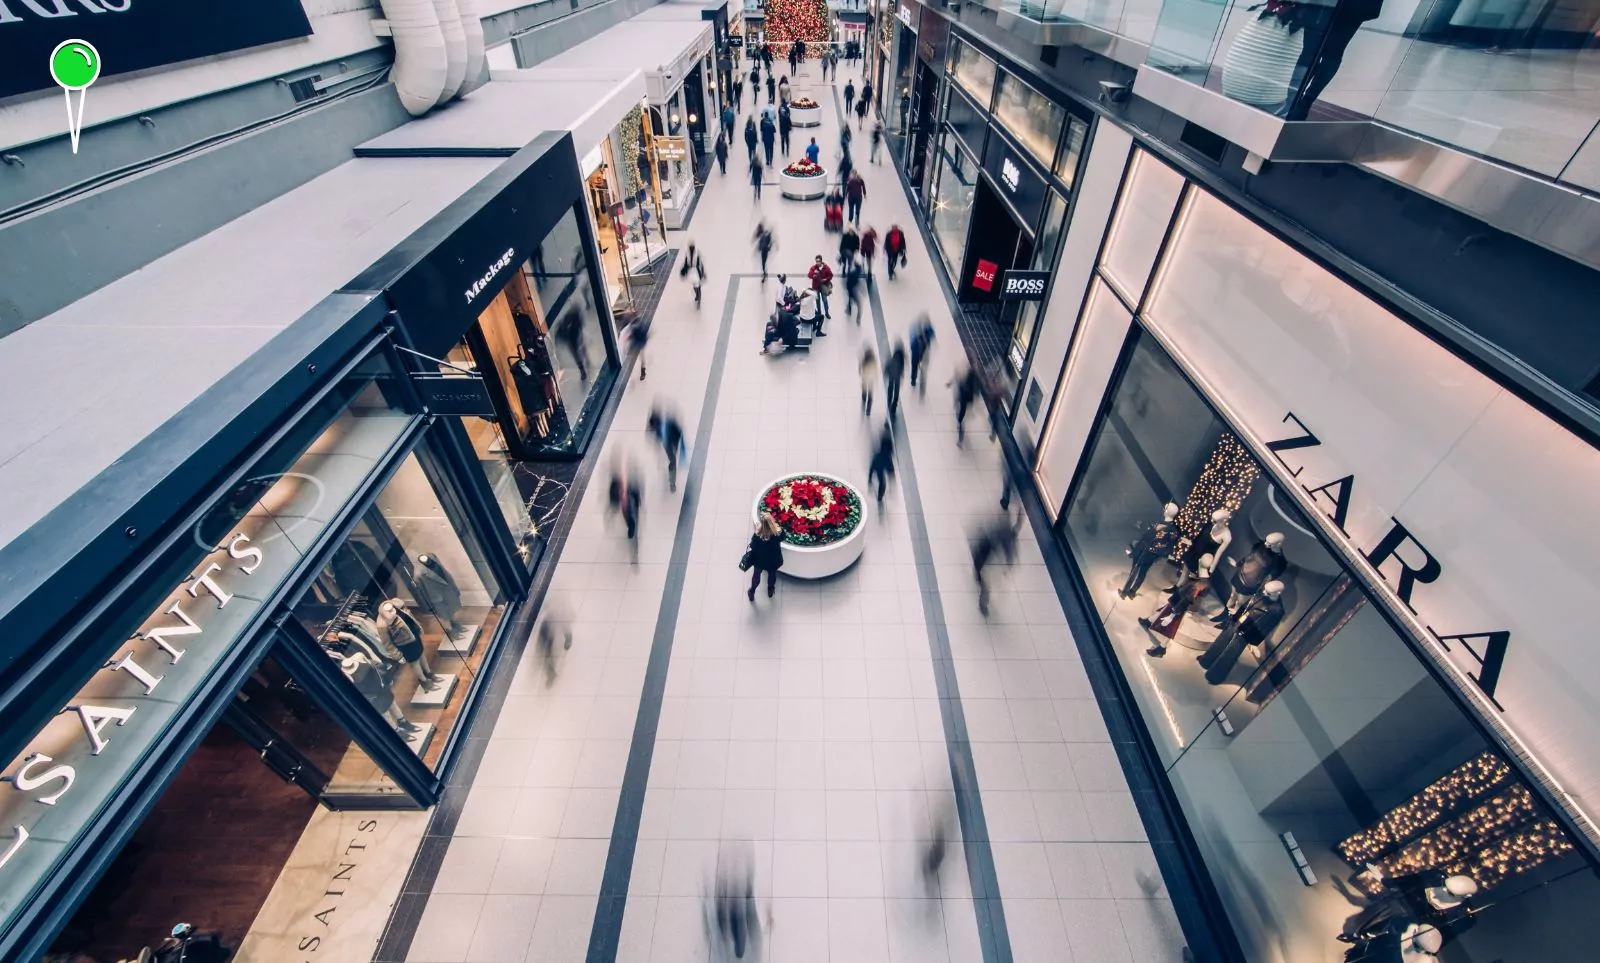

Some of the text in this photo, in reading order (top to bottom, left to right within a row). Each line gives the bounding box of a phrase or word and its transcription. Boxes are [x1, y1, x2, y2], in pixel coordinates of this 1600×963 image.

[464, 248, 514, 304] Mackage
[975, 269, 995, 282] SALE
[1006, 279, 1044, 290] BOSS
[1265, 411, 1510, 713] ZARA
[298, 820, 377, 963] SAINTS
